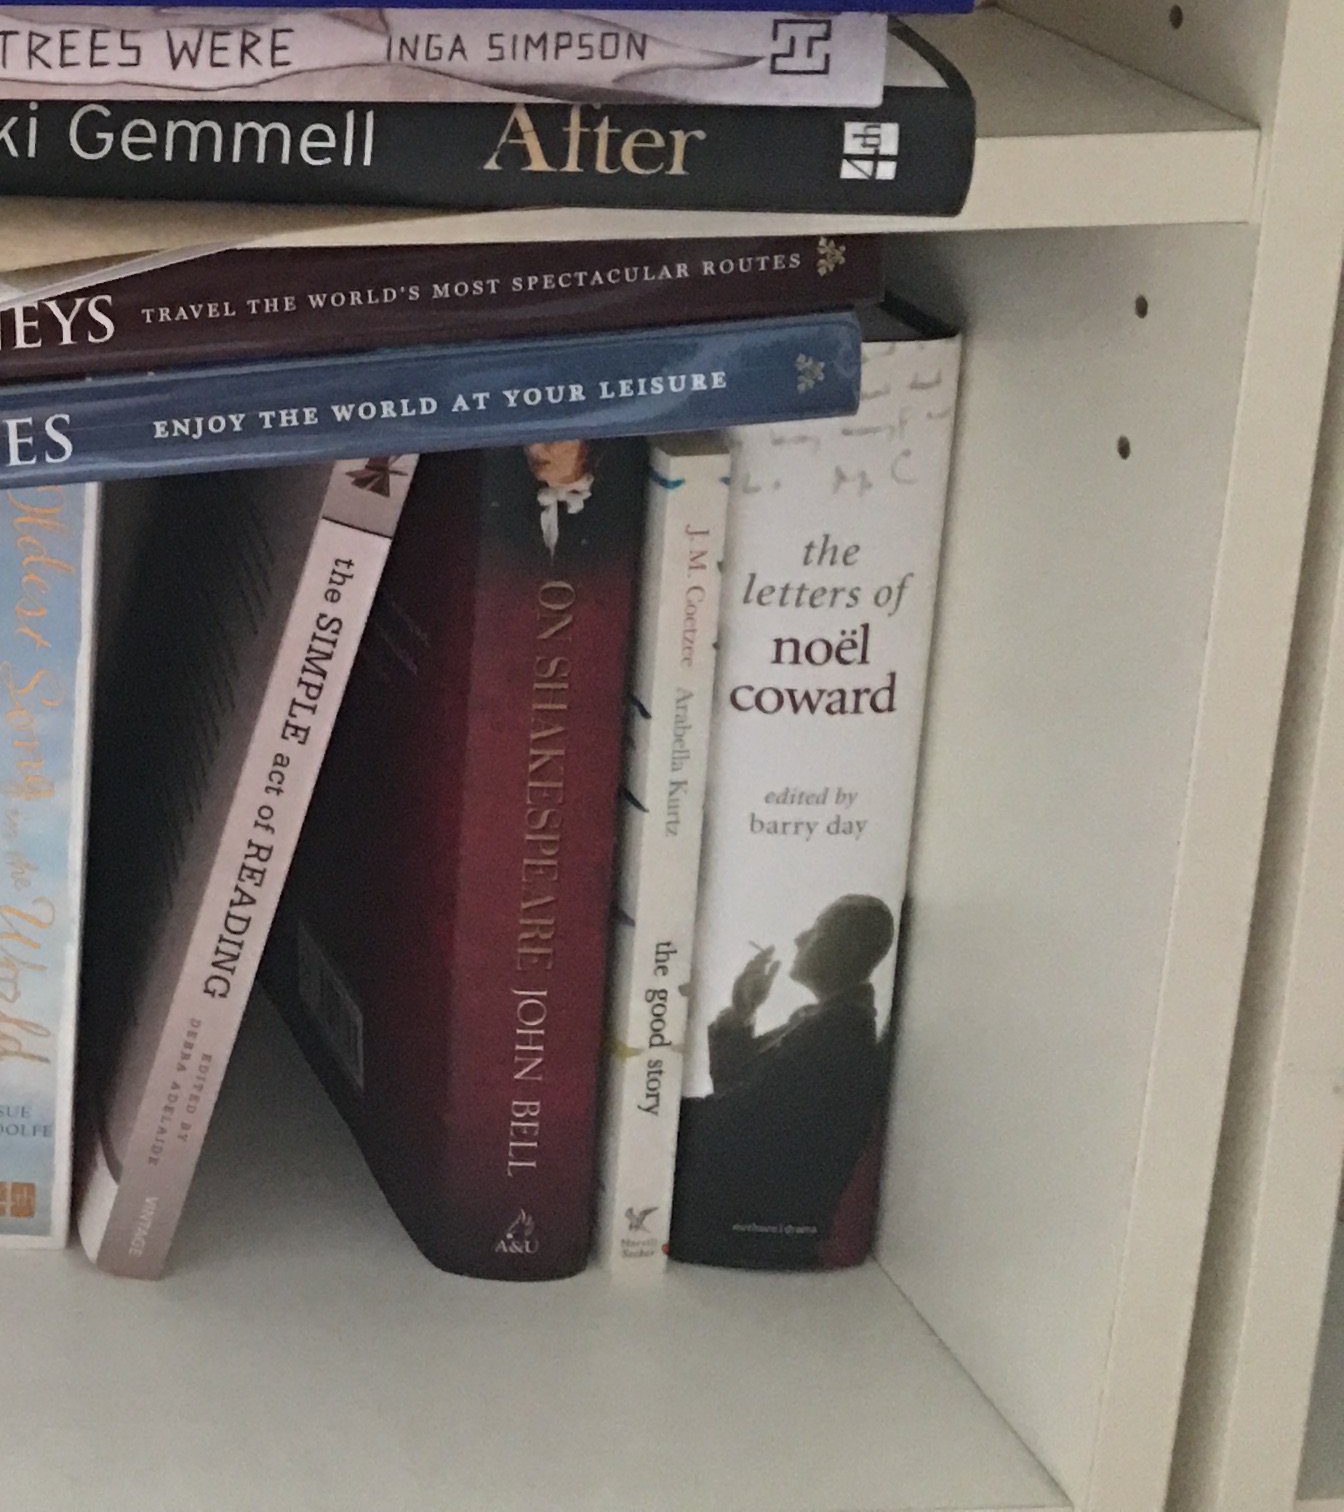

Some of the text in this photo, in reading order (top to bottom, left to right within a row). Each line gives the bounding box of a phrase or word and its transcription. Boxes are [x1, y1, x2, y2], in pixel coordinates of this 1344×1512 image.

[165, 28, 294, 70] WERE
[385, 31, 649, 64] INGA SIMPSON
[68, 103, 375, 169] Gemmell
[483, 102, 707, 176] After
[141, 251, 803, 326] TRAVEL THE WORLD'S MOST SPECTACULAR ROUTES
[152, 370, 729, 441] ENJOY THE WORLD AT YOUR LEISURE
[802, 534, 862, 568] the
[742, 573, 862, 609] letters
[770, 623, 871, 667] noël
[729, 672, 897, 717] coward
[202, 611, 344, 1000] SIMPLE READING
[764, 787, 859, 809] edited by
[749, 813, 868, 842] barry day
[507, 579, 576, 1177] ON SHAKESPEARE JOHN BELL
[644, 987, 673, 1049] good
